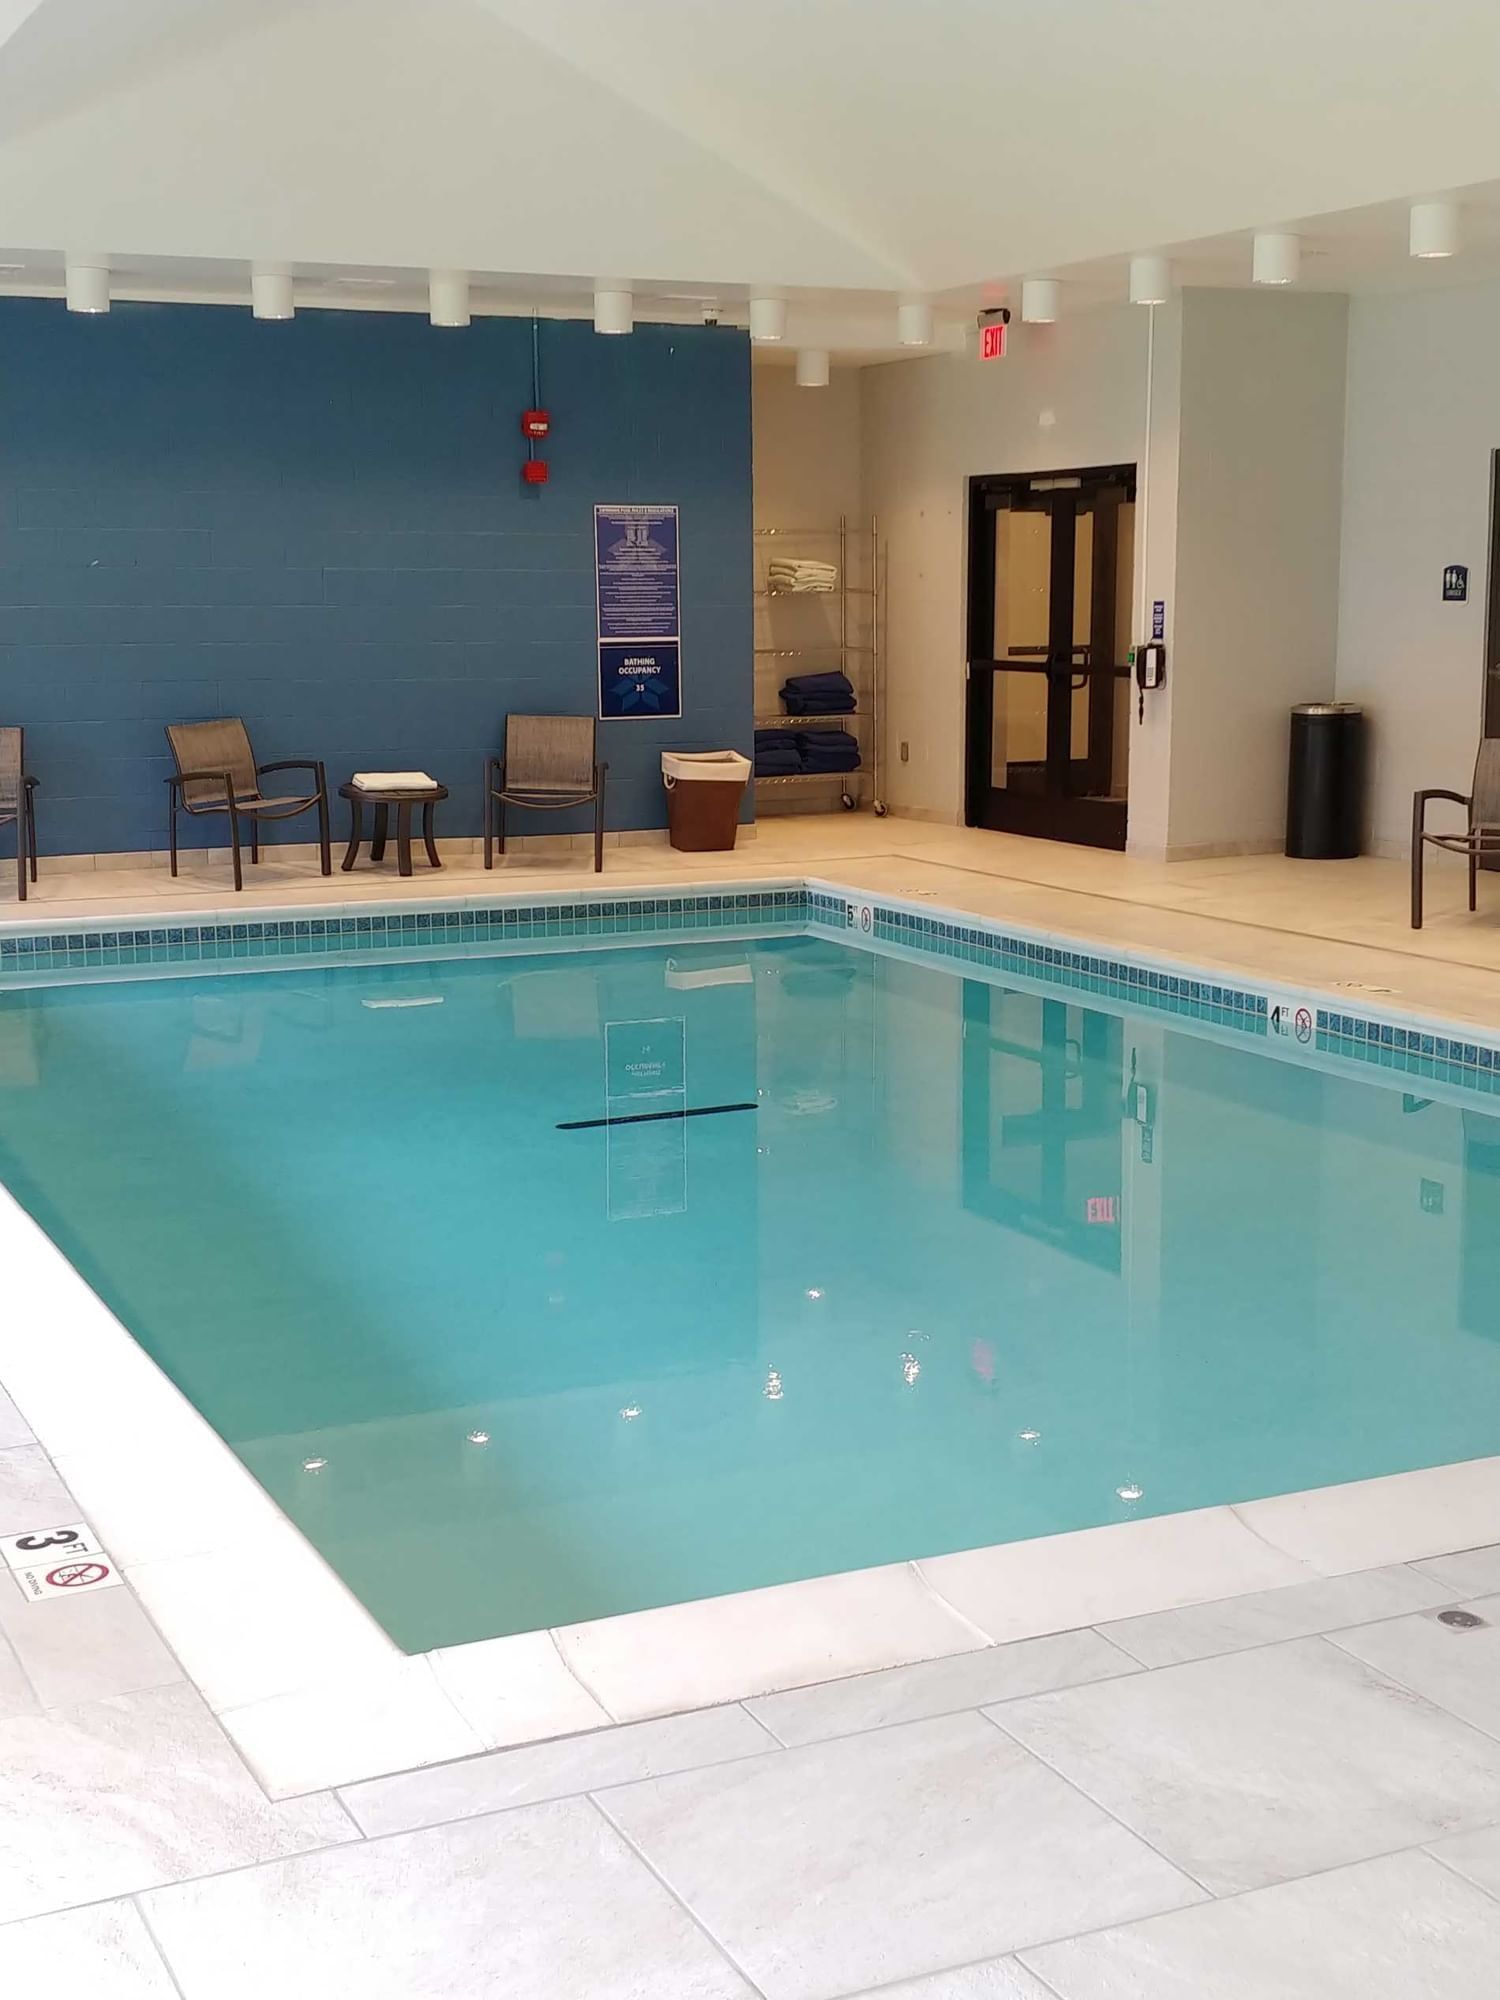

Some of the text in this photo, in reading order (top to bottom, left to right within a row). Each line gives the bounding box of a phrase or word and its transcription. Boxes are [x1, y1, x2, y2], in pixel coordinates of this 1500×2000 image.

[984, 326, 1004, 358] EXIT
[624, 657, 656, 666] BATHING
[618, 666, 662, 675] OCCUPANCY
[1281, 1007, 1290, 1017] FT
[16, 1530, 89, 1554] 3 FT
[28, 1579, 43, 1596] DIVING
